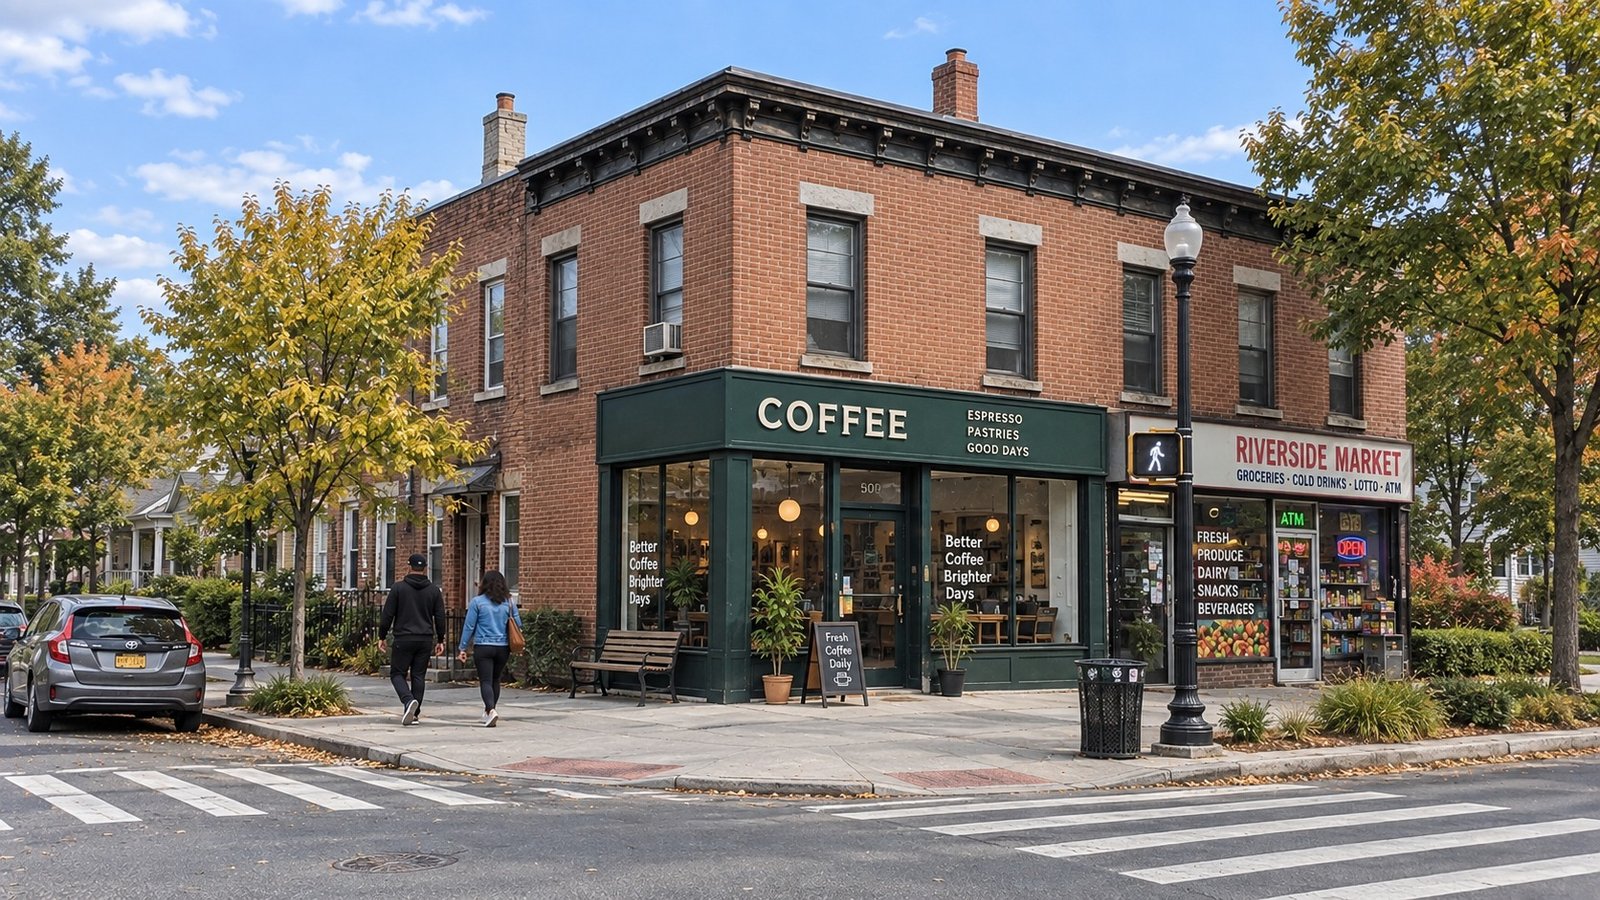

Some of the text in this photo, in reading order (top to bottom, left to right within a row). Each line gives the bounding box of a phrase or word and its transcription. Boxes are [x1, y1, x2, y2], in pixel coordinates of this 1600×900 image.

[757, 397, 908, 440] COFFEE
[967, 409, 1023, 425] ESPRESSO
[967, 426, 1020, 441] PASTRIES
[966, 442, 1030, 457] GOOD DAYS
[1236, 435, 1402, 477] RIVERSIDE MARKET
[1236, 468, 1402, 495] GROCERIES COLD DRINKS LOTTO ATM
[1280, 511, 1304, 526] ATM
[945, 534, 983, 549] Better
[1197, 531, 1229, 544] FRESH
[629, 540, 658, 553] Better
[1338, 540, 1365, 556] OPEN
[945, 552, 984, 566] Coffee
[1197, 548, 1244, 562] PRODUCE
[629, 557, 658, 571] Coffee
[944, 569, 992, 586] Brighter
[1197, 566, 1229, 580] DAIRY
[629, 574, 664, 591] Brighter
[946, 586, 975, 603] Days
[1197, 583, 1239, 598] SNACKS
[629, 591, 651, 608] Days
[1198, 602, 1255, 615] BEVERAGES
[825, 632, 849, 642] Fresh
[825, 645, 852, 657] Coffee
[829, 657, 852, 671] Daily
